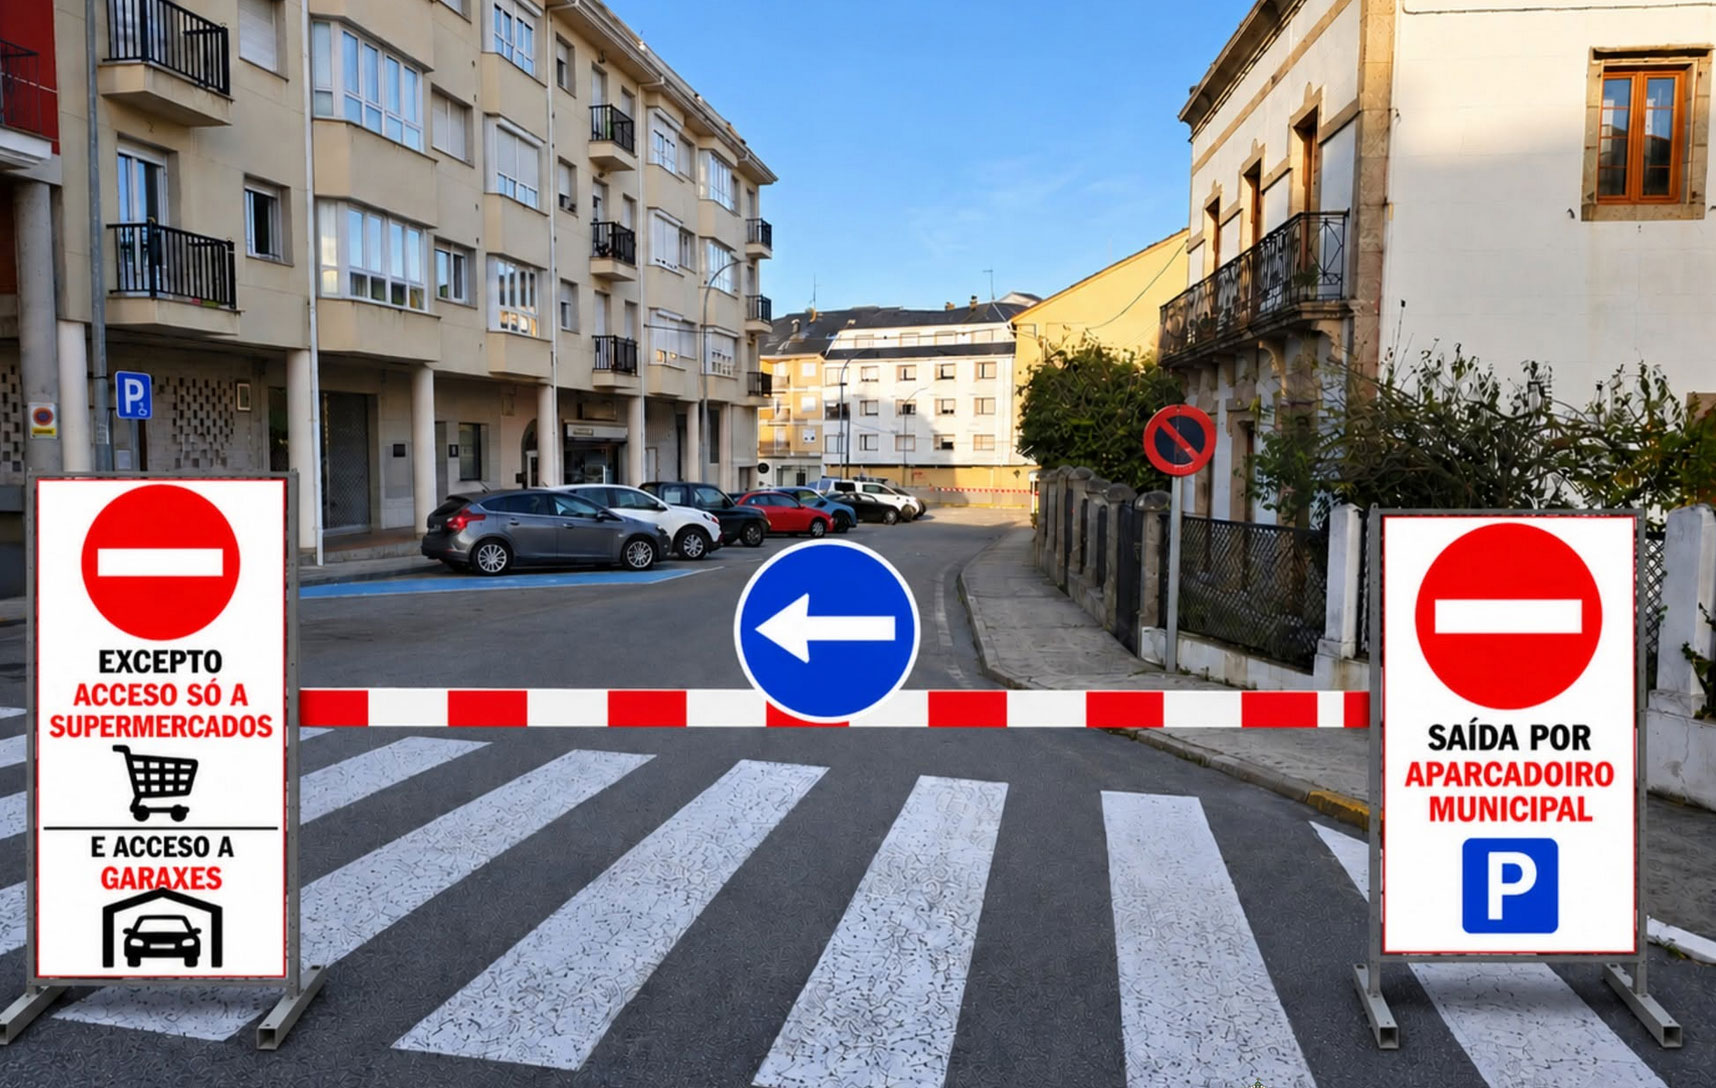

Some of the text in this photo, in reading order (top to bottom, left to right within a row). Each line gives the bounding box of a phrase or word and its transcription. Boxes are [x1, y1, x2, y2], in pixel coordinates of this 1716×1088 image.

[125, 378, 144, 413] P
[99, 649, 223, 674] EXCEPTO
[73, 677, 249, 707] ACCESO SÓ A
[49, 714, 273, 738] SUPERMERCADOS
[1427, 716, 1591, 751] SAÍDA POR
[1404, 761, 1615, 788] APARCADOIRO
[1429, 795, 1593, 823] MUNICIPAL
[91, 835, 235, 858] E ACCESO A
[100, 866, 223, 891] GARAXES
[1487, 851, 1537, 920] P
